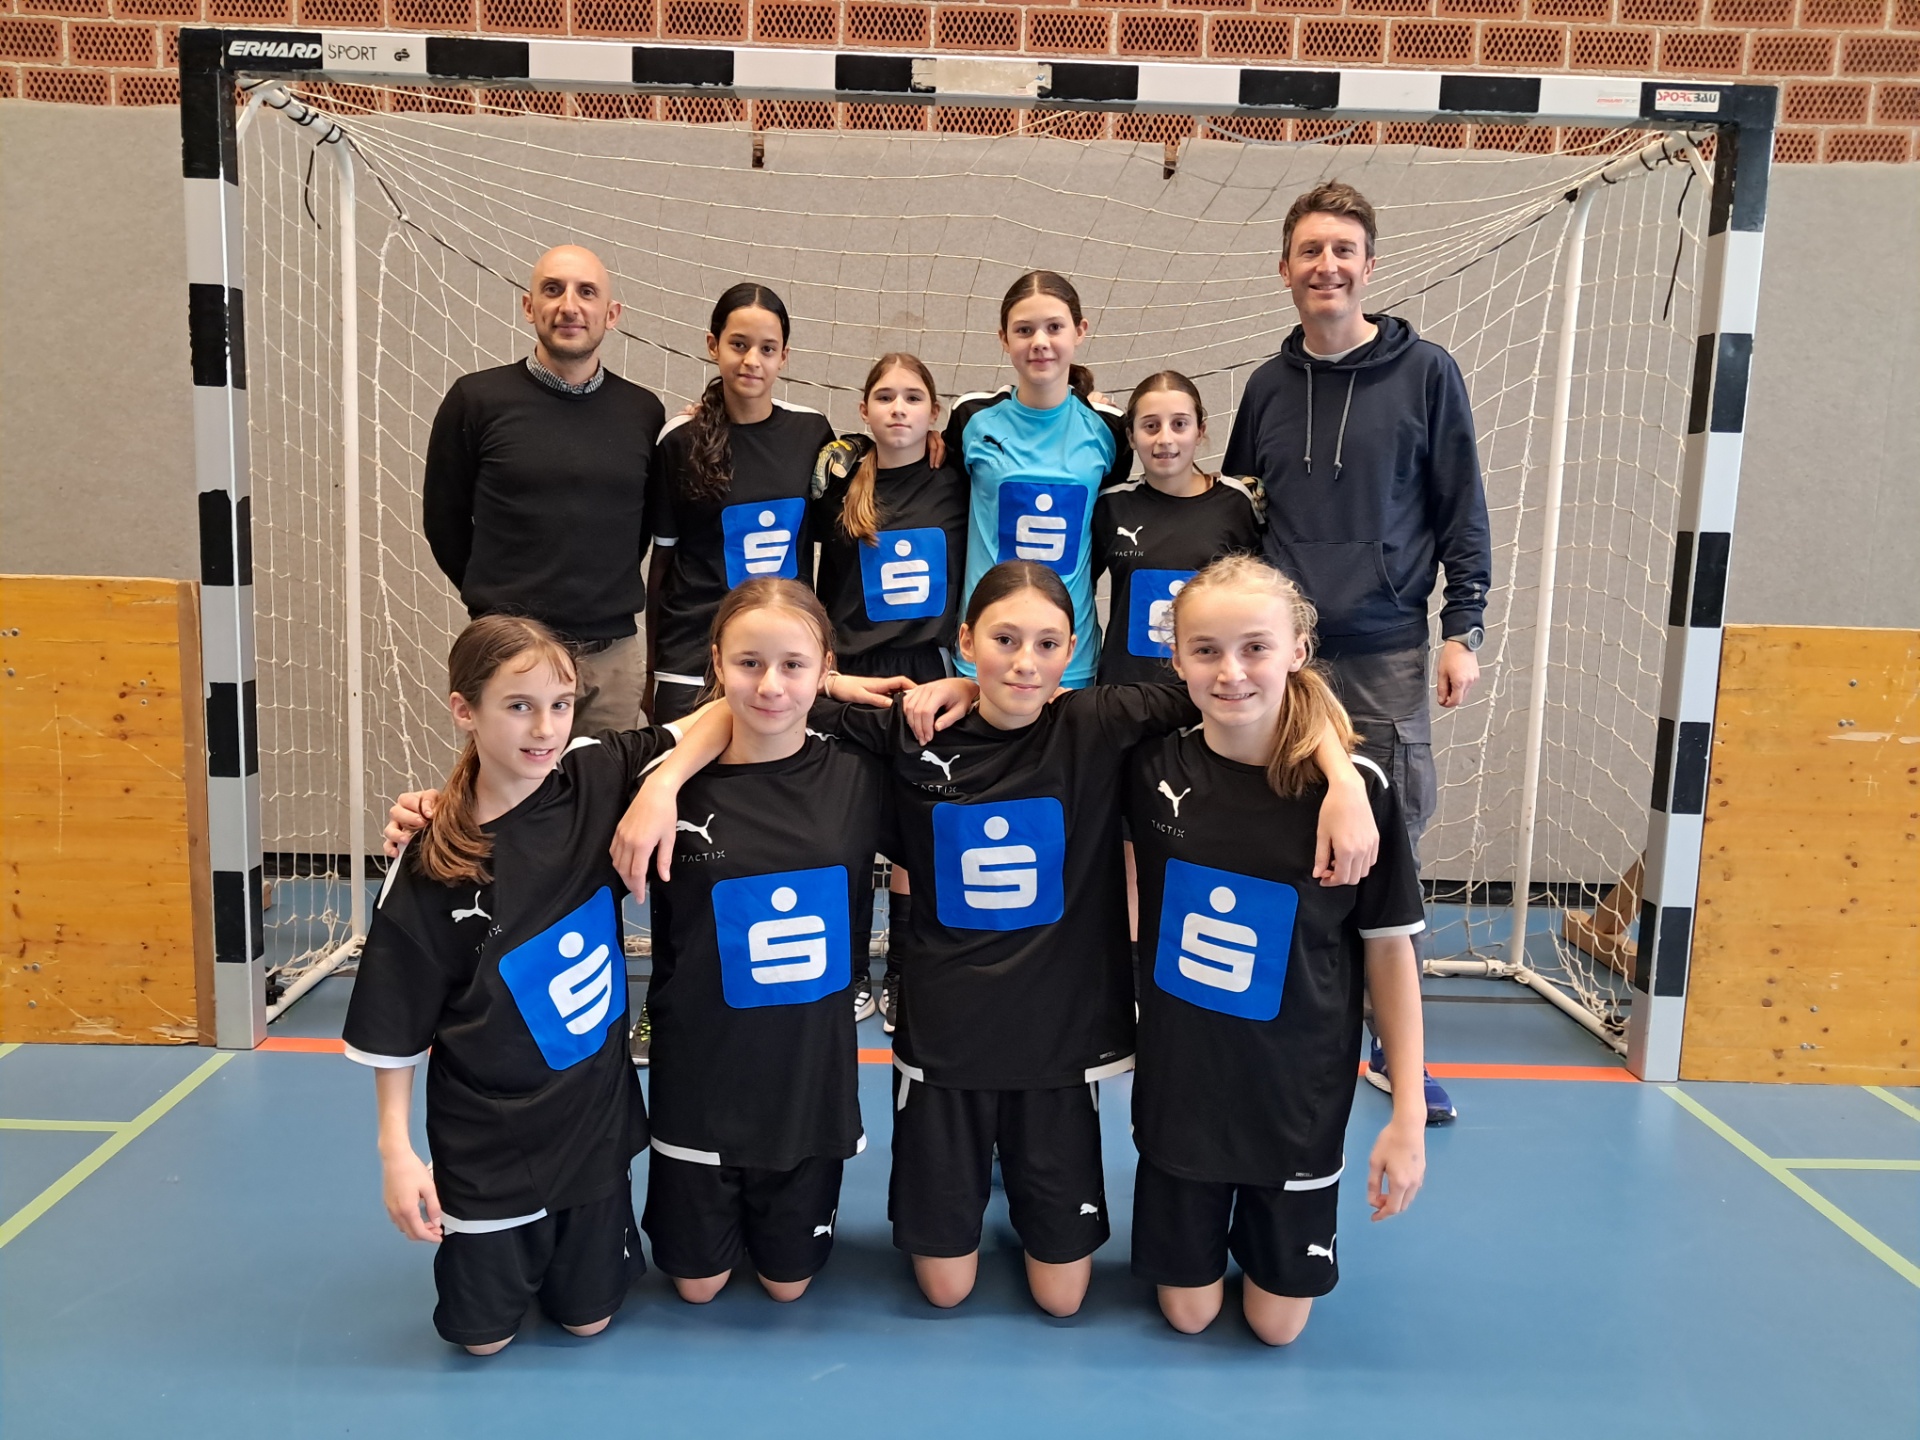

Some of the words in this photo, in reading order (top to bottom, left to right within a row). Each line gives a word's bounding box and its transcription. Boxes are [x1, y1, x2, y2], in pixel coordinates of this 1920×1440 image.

[228, 40, 322, 59] ERHARD
[327, 44, 377, 60] SPORT
[1151, 819, 1185, 839] TACTIX
[680, 850, 726, 863] TACTIX
